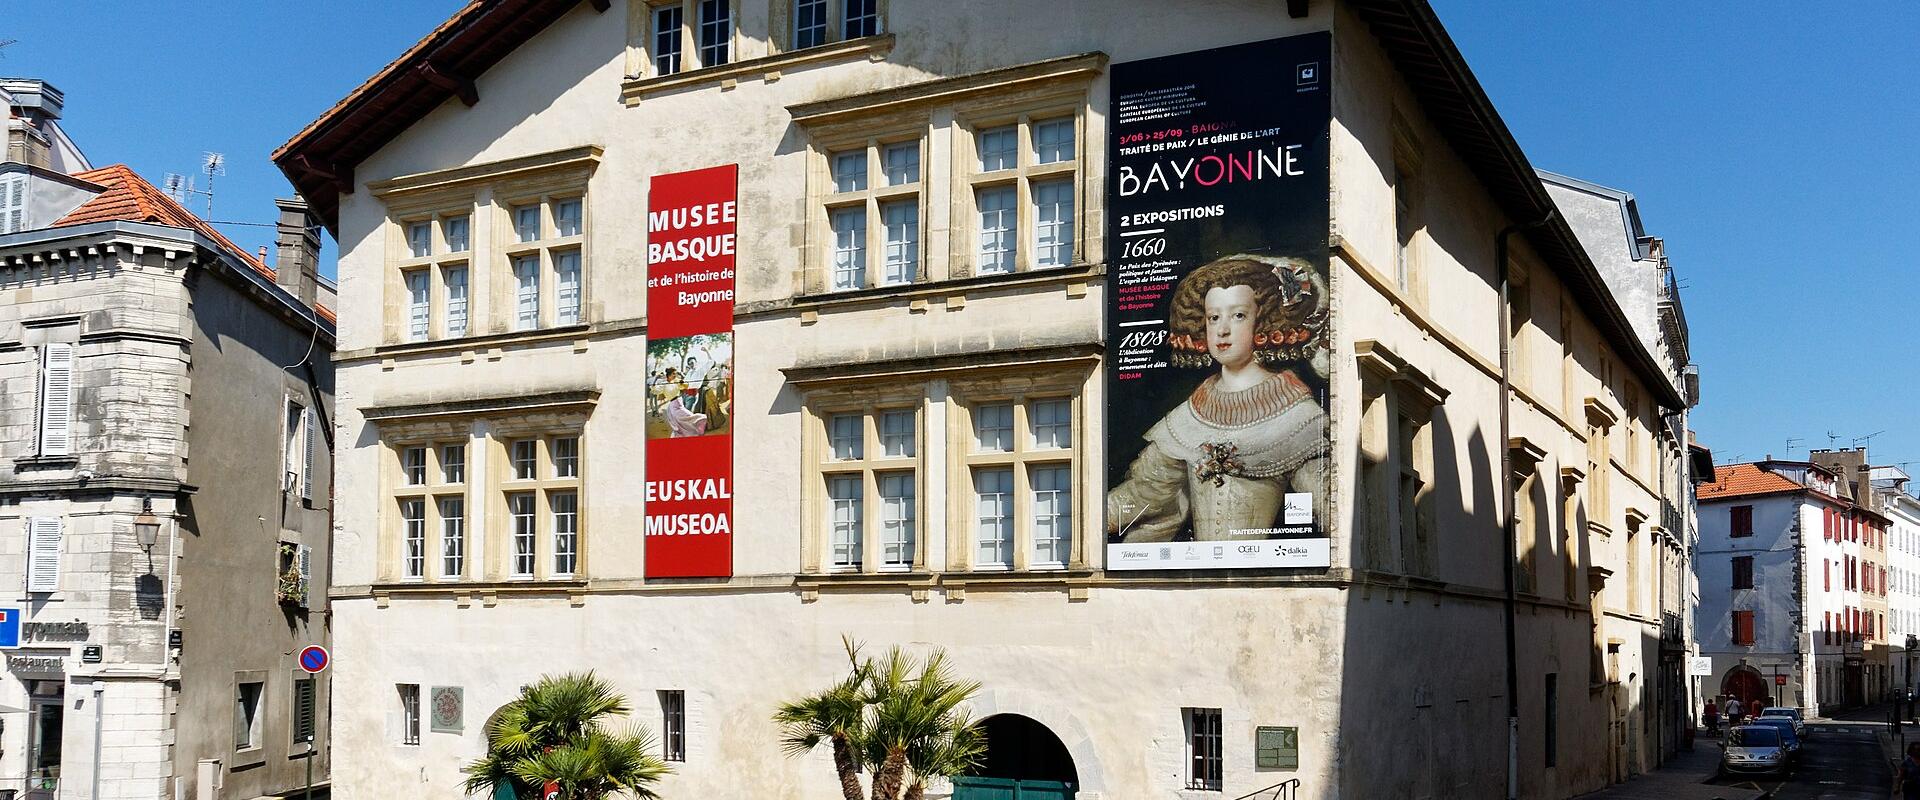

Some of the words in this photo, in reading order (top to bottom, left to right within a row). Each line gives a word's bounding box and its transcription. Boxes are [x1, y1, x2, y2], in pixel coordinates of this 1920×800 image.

[1119, 134, 1144, 145] 3/06
[1153, 128, 1183, 140] 25/09
[1119, 144, 1151, 156] TRAITÉ
[1152, 142, 1165, 151] DE
[1166, 140, 1187, 150] PAIX
[1197, 137, 1209, 146] LE
[1210, 133, 1238, 144] GÉNIE
[1240, 131, 1253, 139] DE
[1255, 127, 1281, 138] L'ART
[1119, 144, 1304, 197] BAYONNE
[649, 201, 736, 233] MUSEE
[1120, 215, 1130, 227] 2
[1133, 204, 1225, 226] EXPOSITIONS
[648, 233, 735, 265] BASQUE
[1121, 237, 1166, 259] 1660
[648, 277, 658, 288] et
[660, 275, 672, 287] de
[675, 270, 719, 285] l'histoire
[720, 268, 734, 280] de
[1143, 283, 1169, 292] BASQUE
[678, 289, 733, 308] Bayonne
[1127, 302, 1154, 310] Bayonne
[1119, 329, 1168, 348] 1808
[1119, 372, 1142, 380] DIDAM
[645, 478, 731, 502] EUSKAL
[645, 512, 731, 536] MUSEOA
[6, 655, 64, 668] Restaurant
